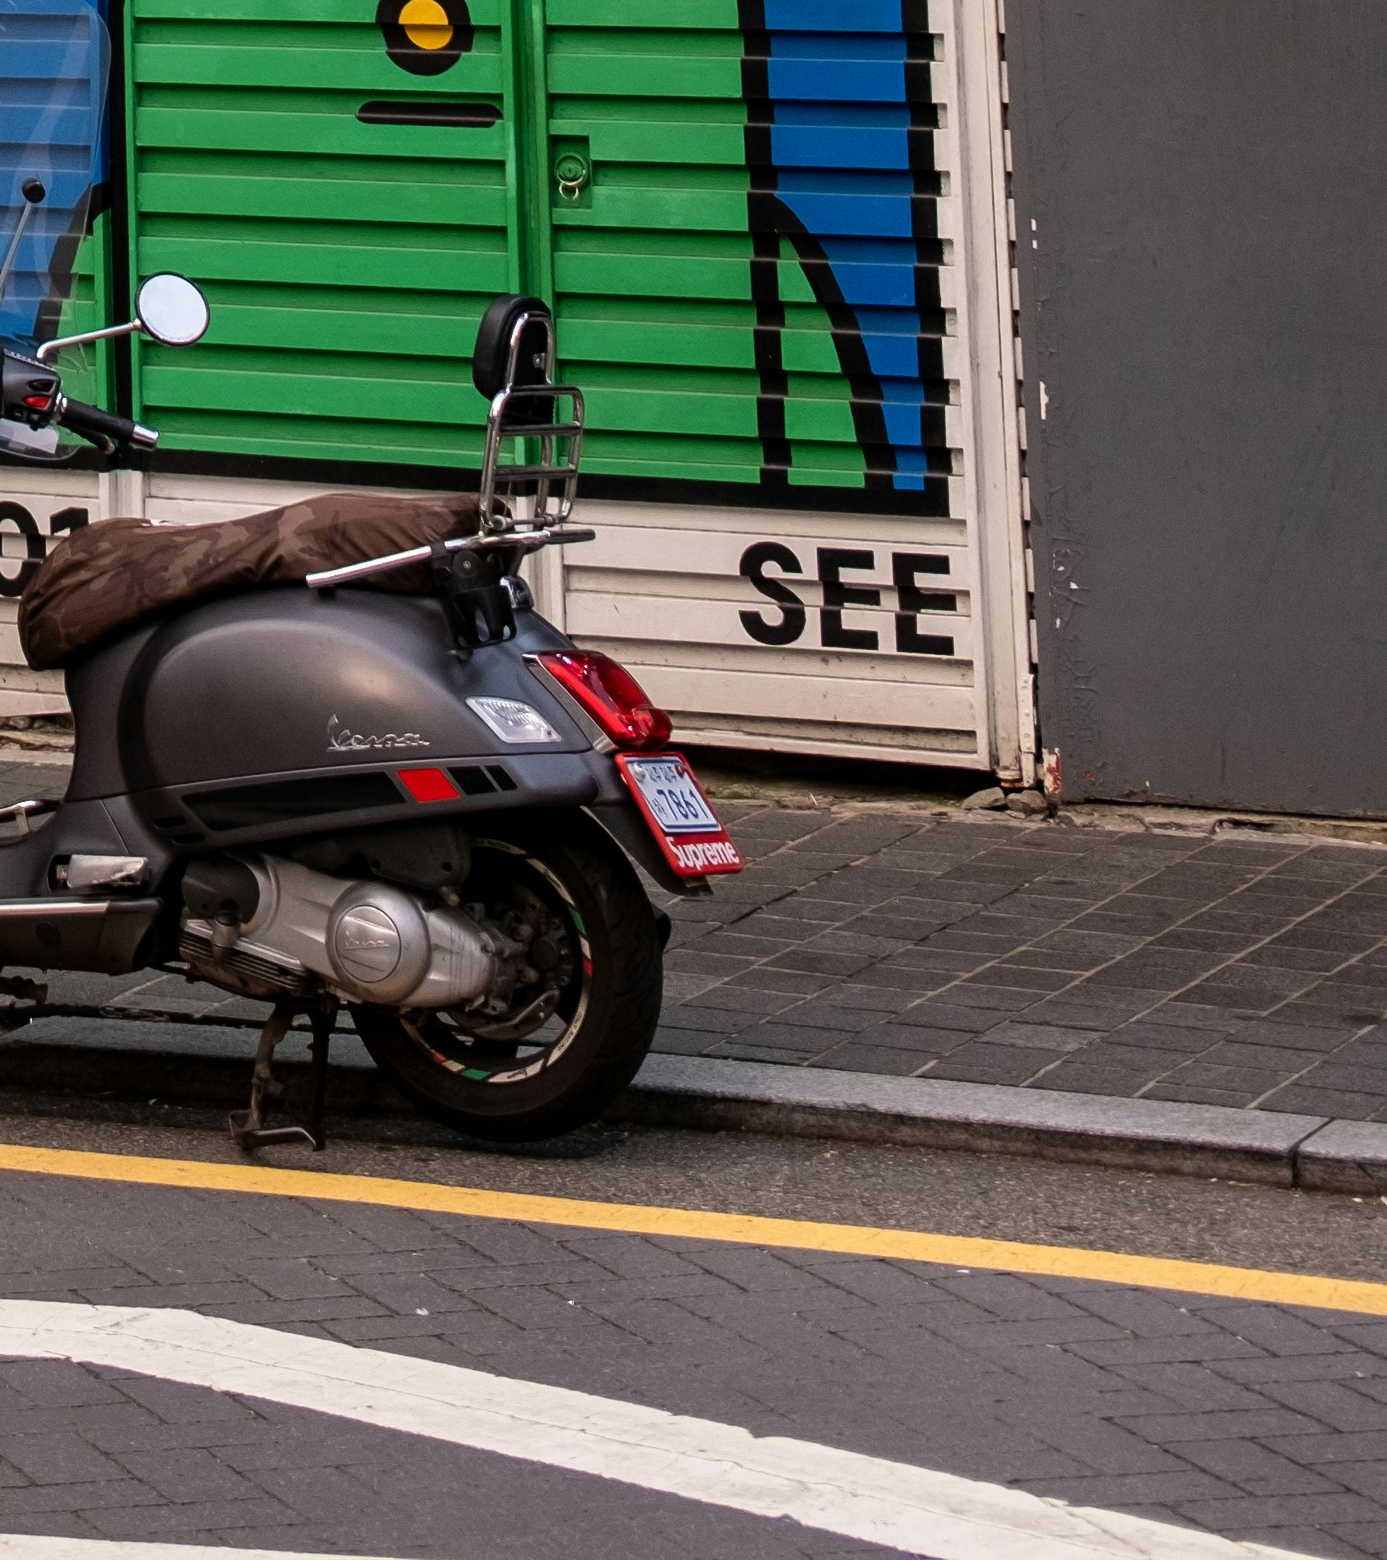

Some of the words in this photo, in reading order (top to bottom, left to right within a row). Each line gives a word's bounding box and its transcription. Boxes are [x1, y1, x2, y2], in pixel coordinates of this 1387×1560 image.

[738, 541, 957, 656] SEE
[326, 713, 431, 752] Vespa
[655, 788, 709, 821] 7861
[665, 836, 740, 870] Supreme
